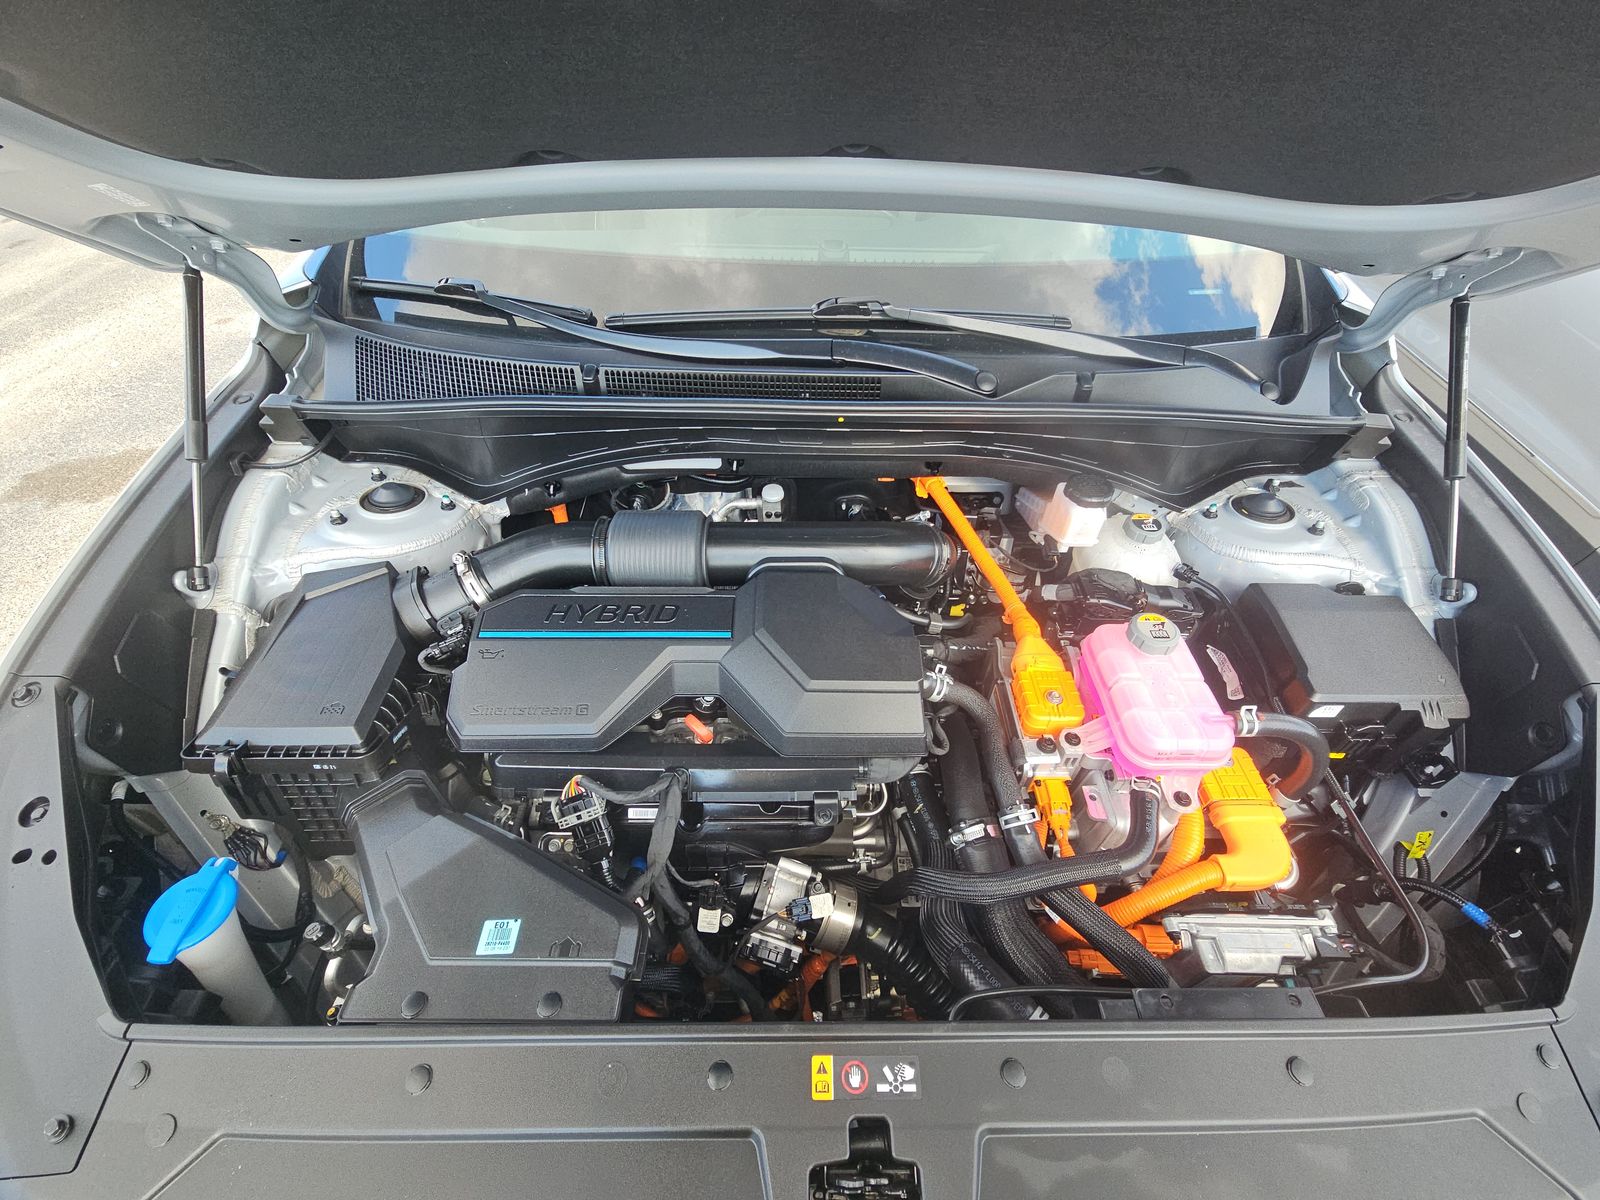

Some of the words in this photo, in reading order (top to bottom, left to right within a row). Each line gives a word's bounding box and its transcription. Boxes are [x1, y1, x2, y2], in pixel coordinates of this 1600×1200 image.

[543, 603, 681, 625] HYBRID
[470, 703, 573, 717] Smartstream
[575, 703, 590, 716] G
[494, 921, 510, 929] E01
